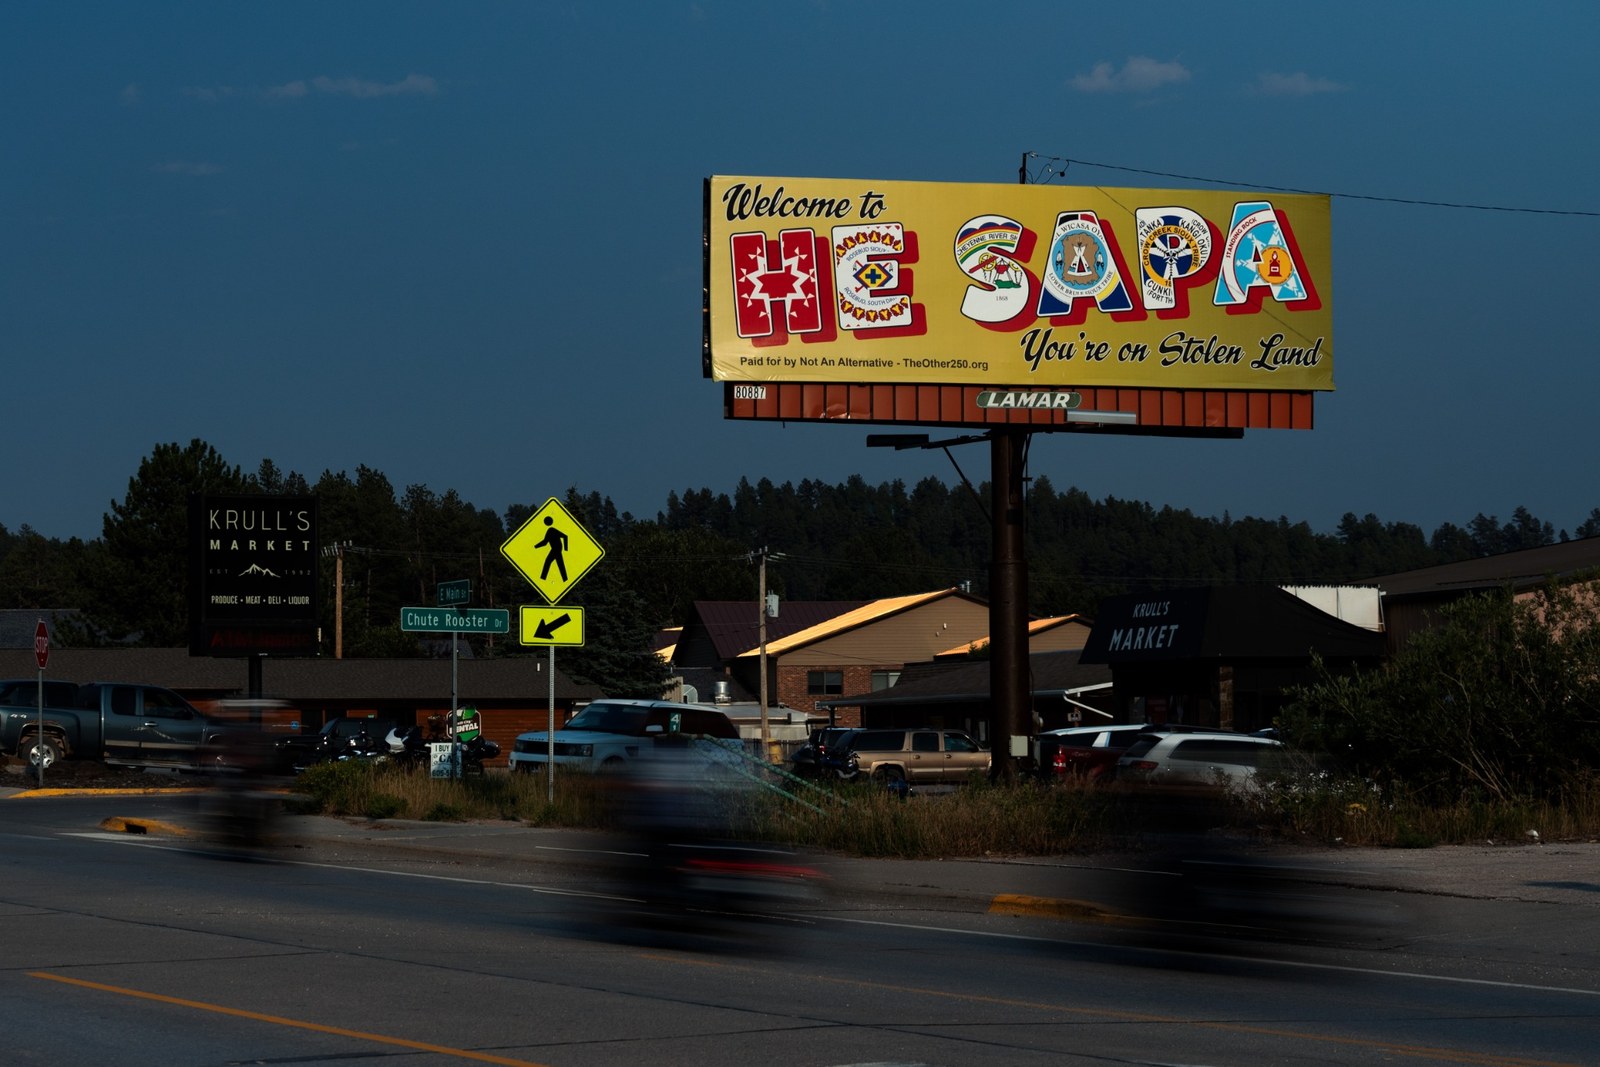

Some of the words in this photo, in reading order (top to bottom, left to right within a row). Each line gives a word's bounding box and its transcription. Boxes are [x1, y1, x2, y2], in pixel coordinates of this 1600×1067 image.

[722, 183, 853, 221] Welcome
[859, 191, 887, 219] to
[957, 235, 986, 256] CHEYENNE
[1143, 241, 1151, 266] CROW
[1149, 227, 1172, 241] CREEK
[1173, 227, 1193, 244] SIOUX
[1226, 228, 1243, 258] STANDING
[1242, 217, 1257, 230] ROCK
[954, 200, 1308, 323] SAPA
[1048, 272, 1065, 291] LOWER
[1020, 328, 1111, 373] You're
[1117, 341, 1151, 362] on
[1158, 331, 1246, 367] Stolen
[1250, 332, 1325, 372] Land
[740, 357, 763, 366] Paid
[766, 357, 781, 366] for
[784, 357, 797, 368] by
[800, 357, 818, 366] Not
[821, 358, 835, 367] An
[838, 358, 894, 368] Alternative
[903, 358, 989, 371] TheOther250.org
[736, 386, 765, 398] 80887
[986, 392, 1071, 408] LAMAR
[209, 509, 311, 531] KRULL'S
[209, 539, 311, 551] MARKET
[211, 595, 239, 605] PRODUCE
[245, 595, 261, 605] MEAT
[267, 595, 281, 605] DELI
[288, 595, 310, 605] LIQUOR
[440, 588, 445, 601] E
[445, 586, 461, 601] Main
[1132, 601, 1170, 618] KRULL'S
[407, 612, 439, 626] Chute
[445, 613, 489, 627] Rooster
[494, 618, 503, 628] Dr
[36, 636, 48, 654] STOP
[1108, 624, 1180, 652] MARKET
